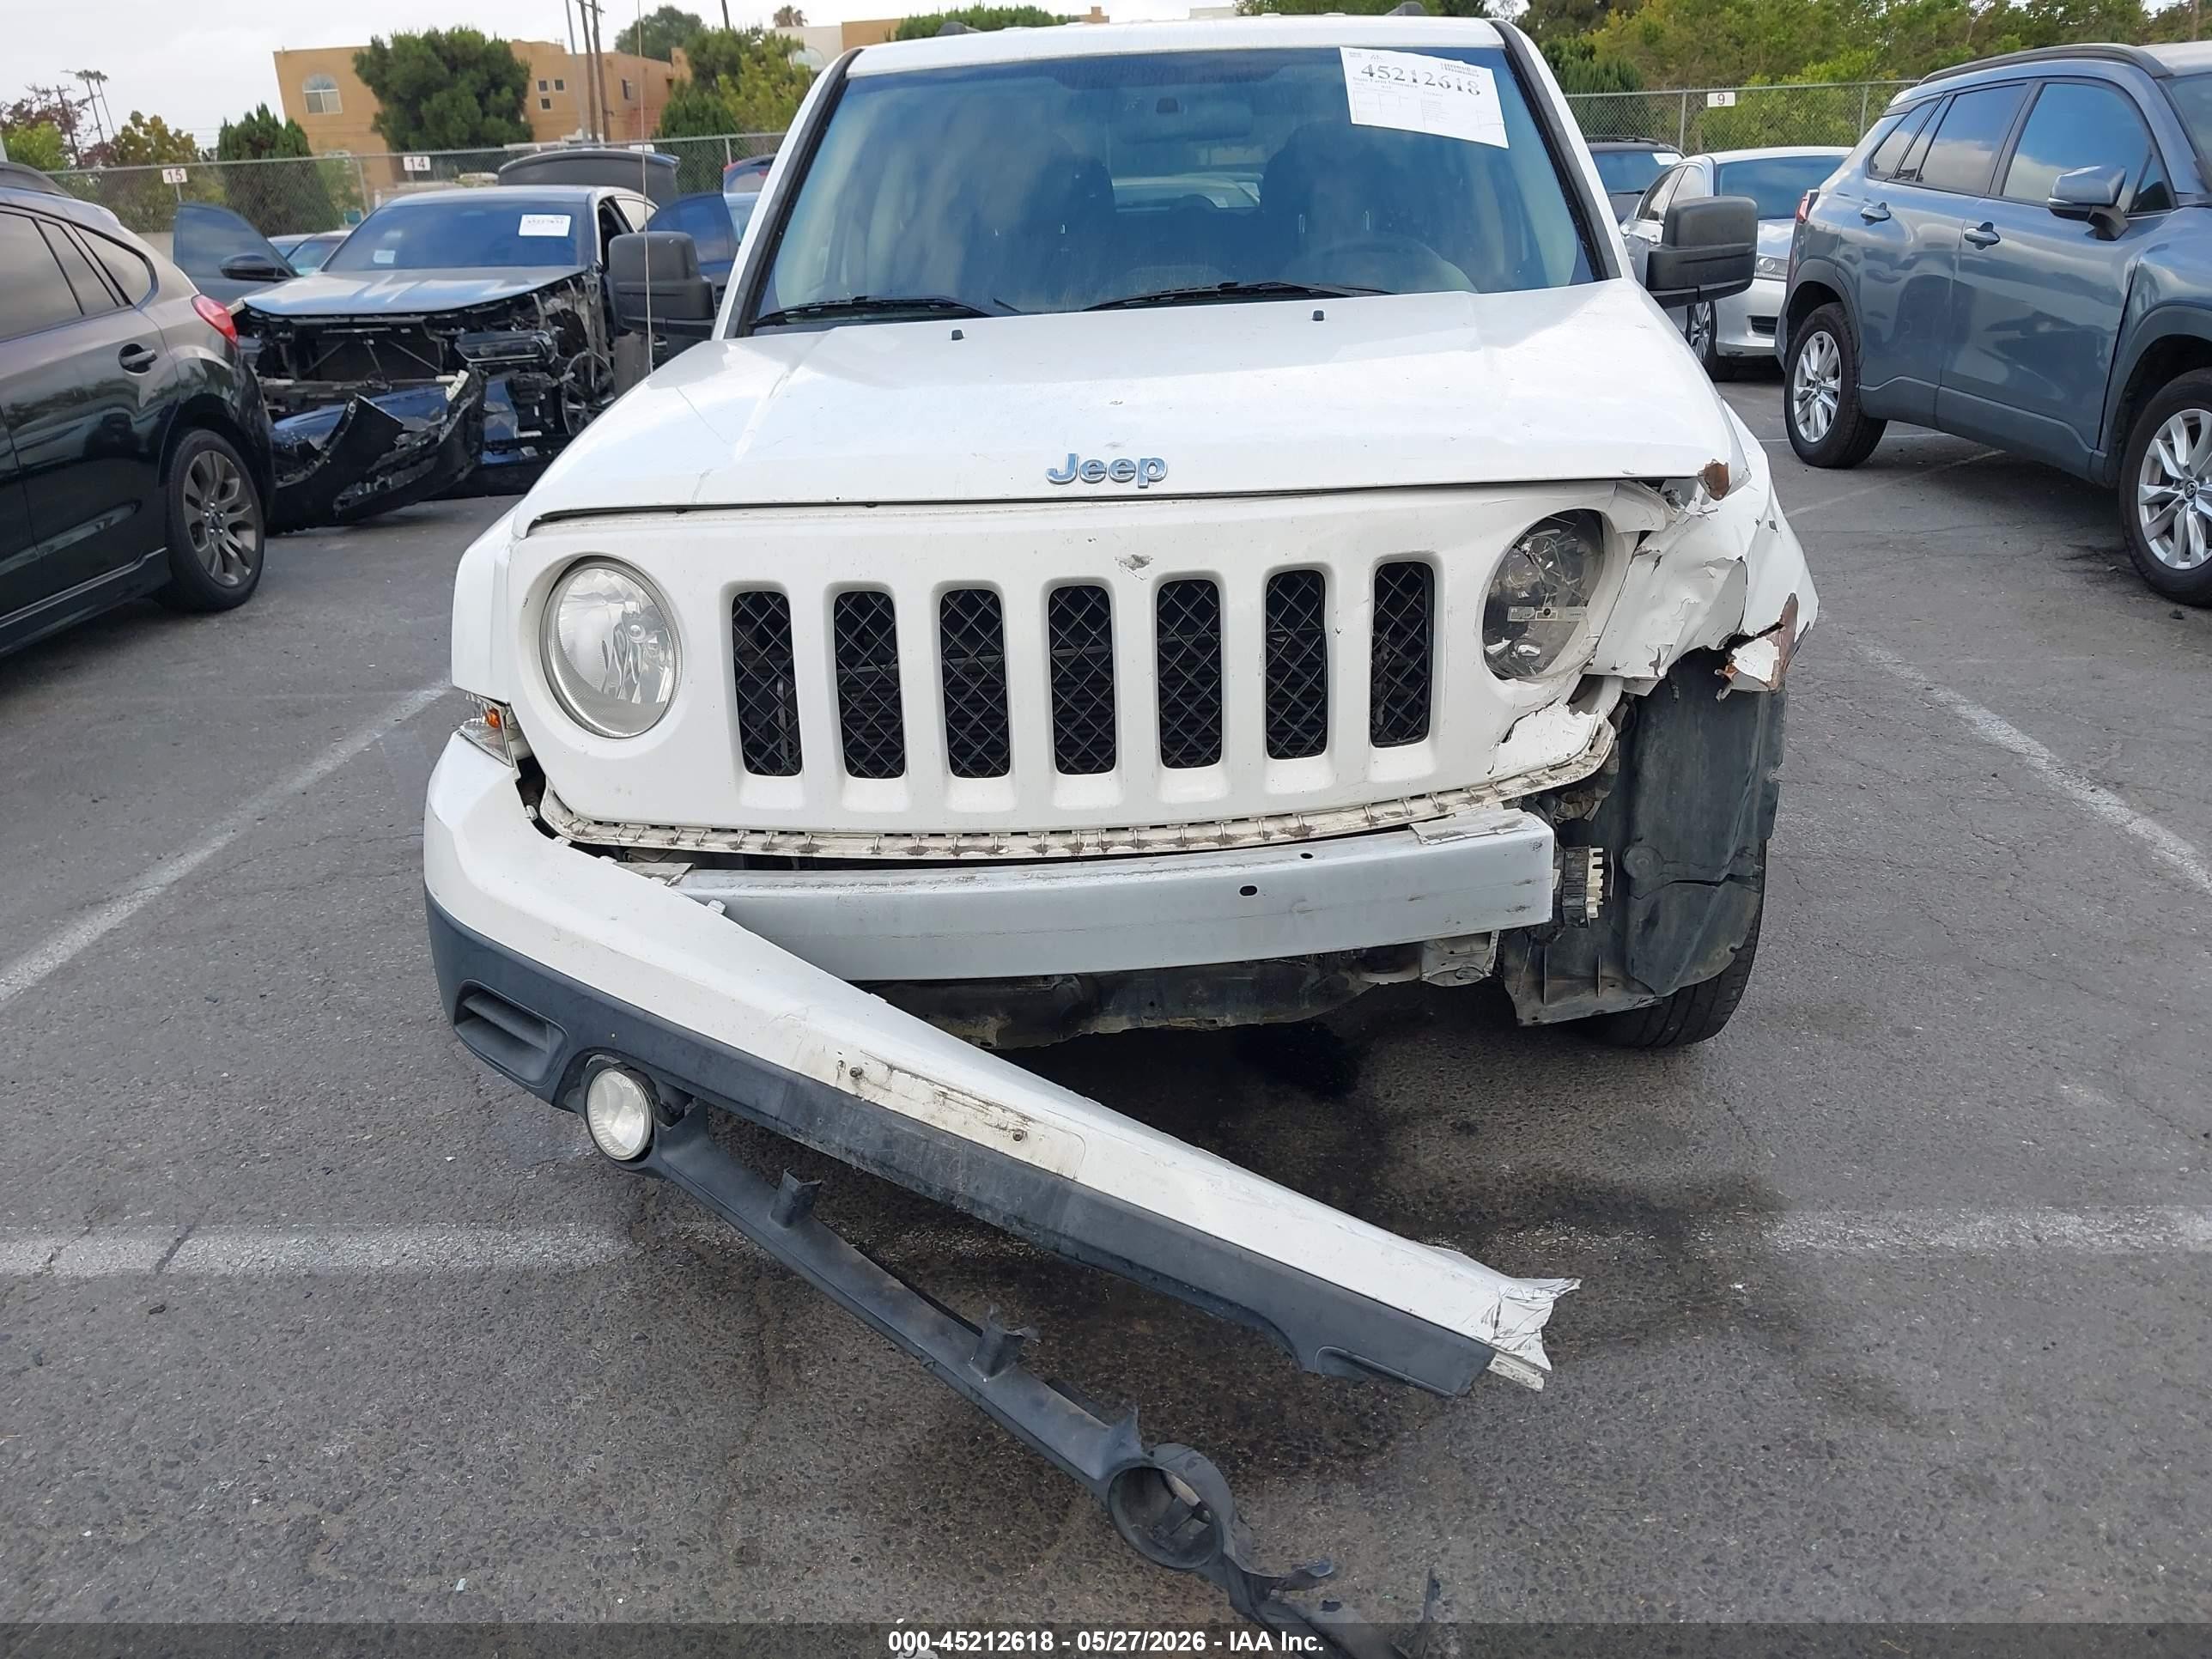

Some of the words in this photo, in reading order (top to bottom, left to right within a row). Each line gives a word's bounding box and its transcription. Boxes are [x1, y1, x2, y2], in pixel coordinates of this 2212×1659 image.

[1361, 64, 1480, 96] 45212618
[1717, 94, 1725, 105] 9
[410, 157, 426, 170] 14
[167, 169, 183, 182] 15
[1046, 453, 1168, 489] Jeep
